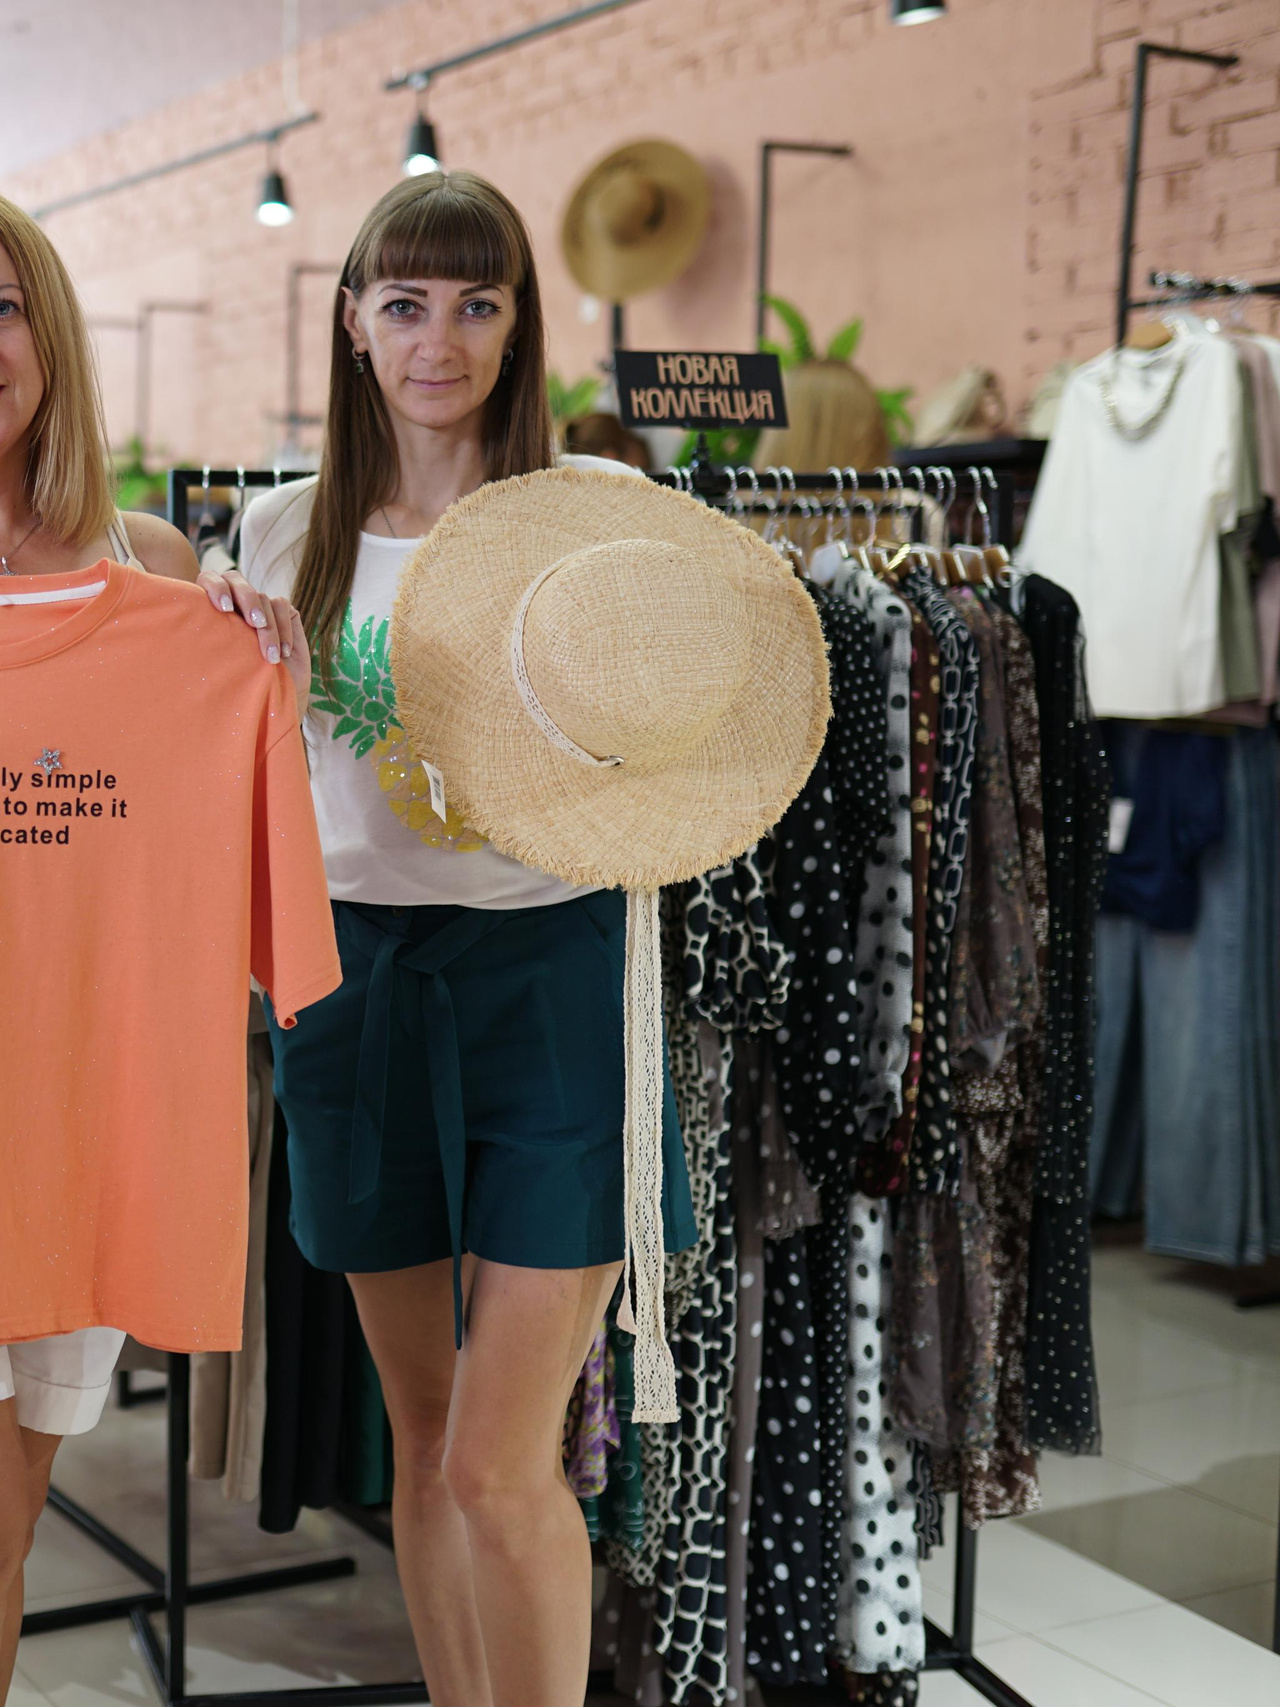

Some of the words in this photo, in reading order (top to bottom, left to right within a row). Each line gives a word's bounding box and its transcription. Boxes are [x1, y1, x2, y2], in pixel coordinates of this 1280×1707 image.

[656, 354, 740, 386] НОВАЯ
[630, 388, 775, 424] КОЛЛЕКЦИЯ
[31, 769, 117, 793] simple
[4, 797, 28, 816] to
[36, 798, 103, 817] make
[111, 799, 127, 818] it
